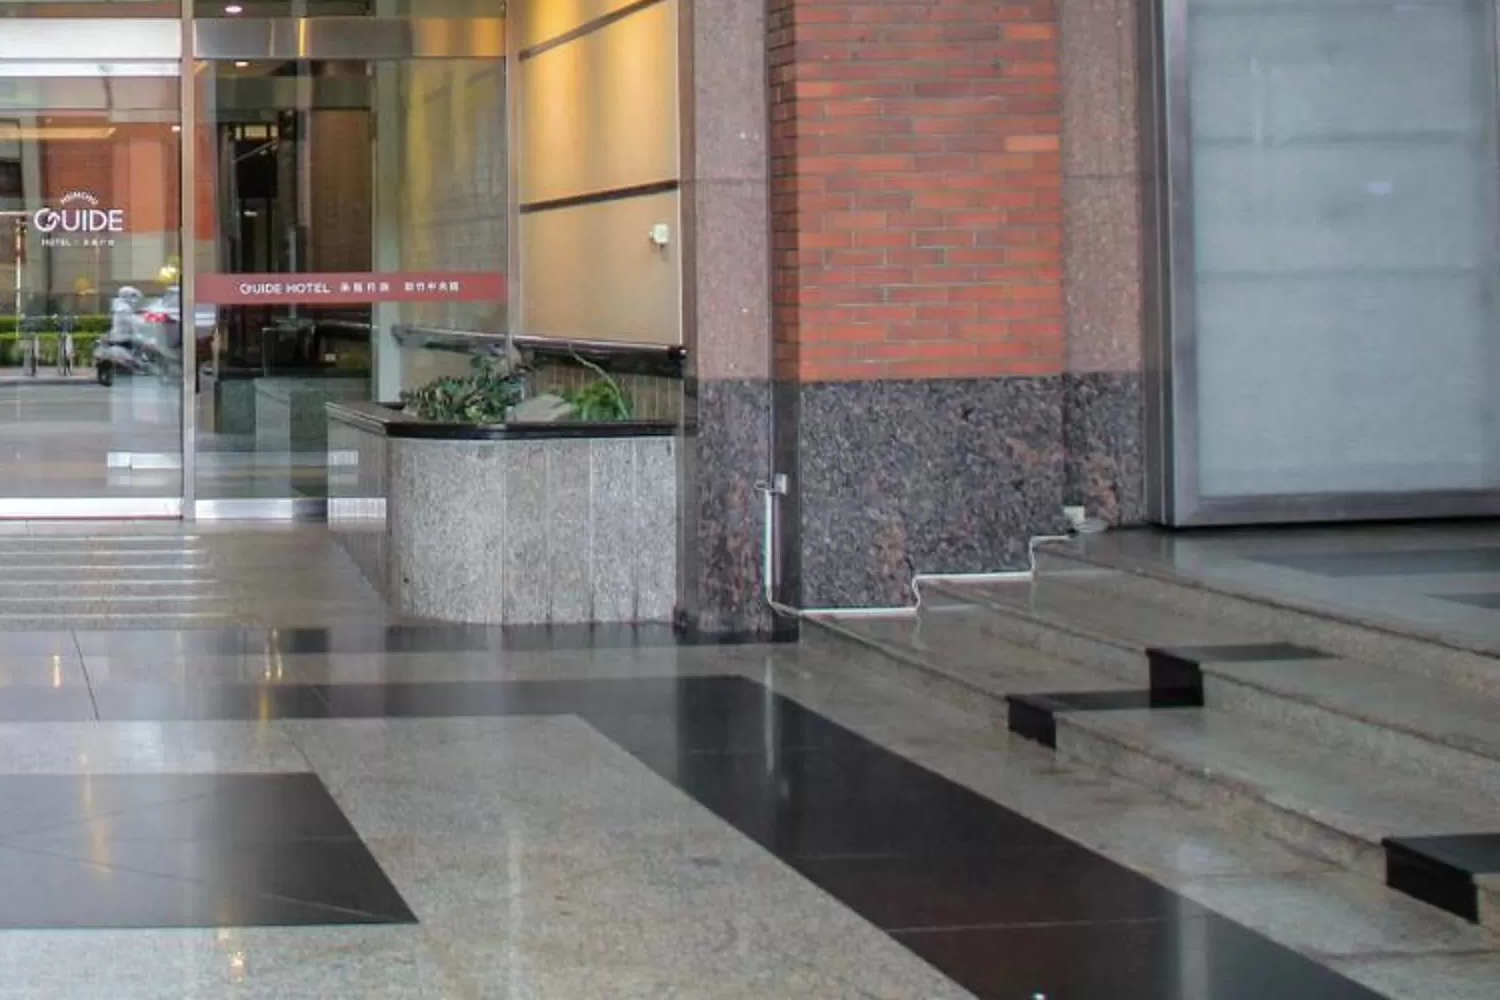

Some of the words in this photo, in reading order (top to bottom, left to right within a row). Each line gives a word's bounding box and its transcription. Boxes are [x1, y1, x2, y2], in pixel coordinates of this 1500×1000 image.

[34, 207, 125, 232] GUIDE
[239, 282, 283, 295] GUIDE
[286, 282, 331, 294] HOTEL
